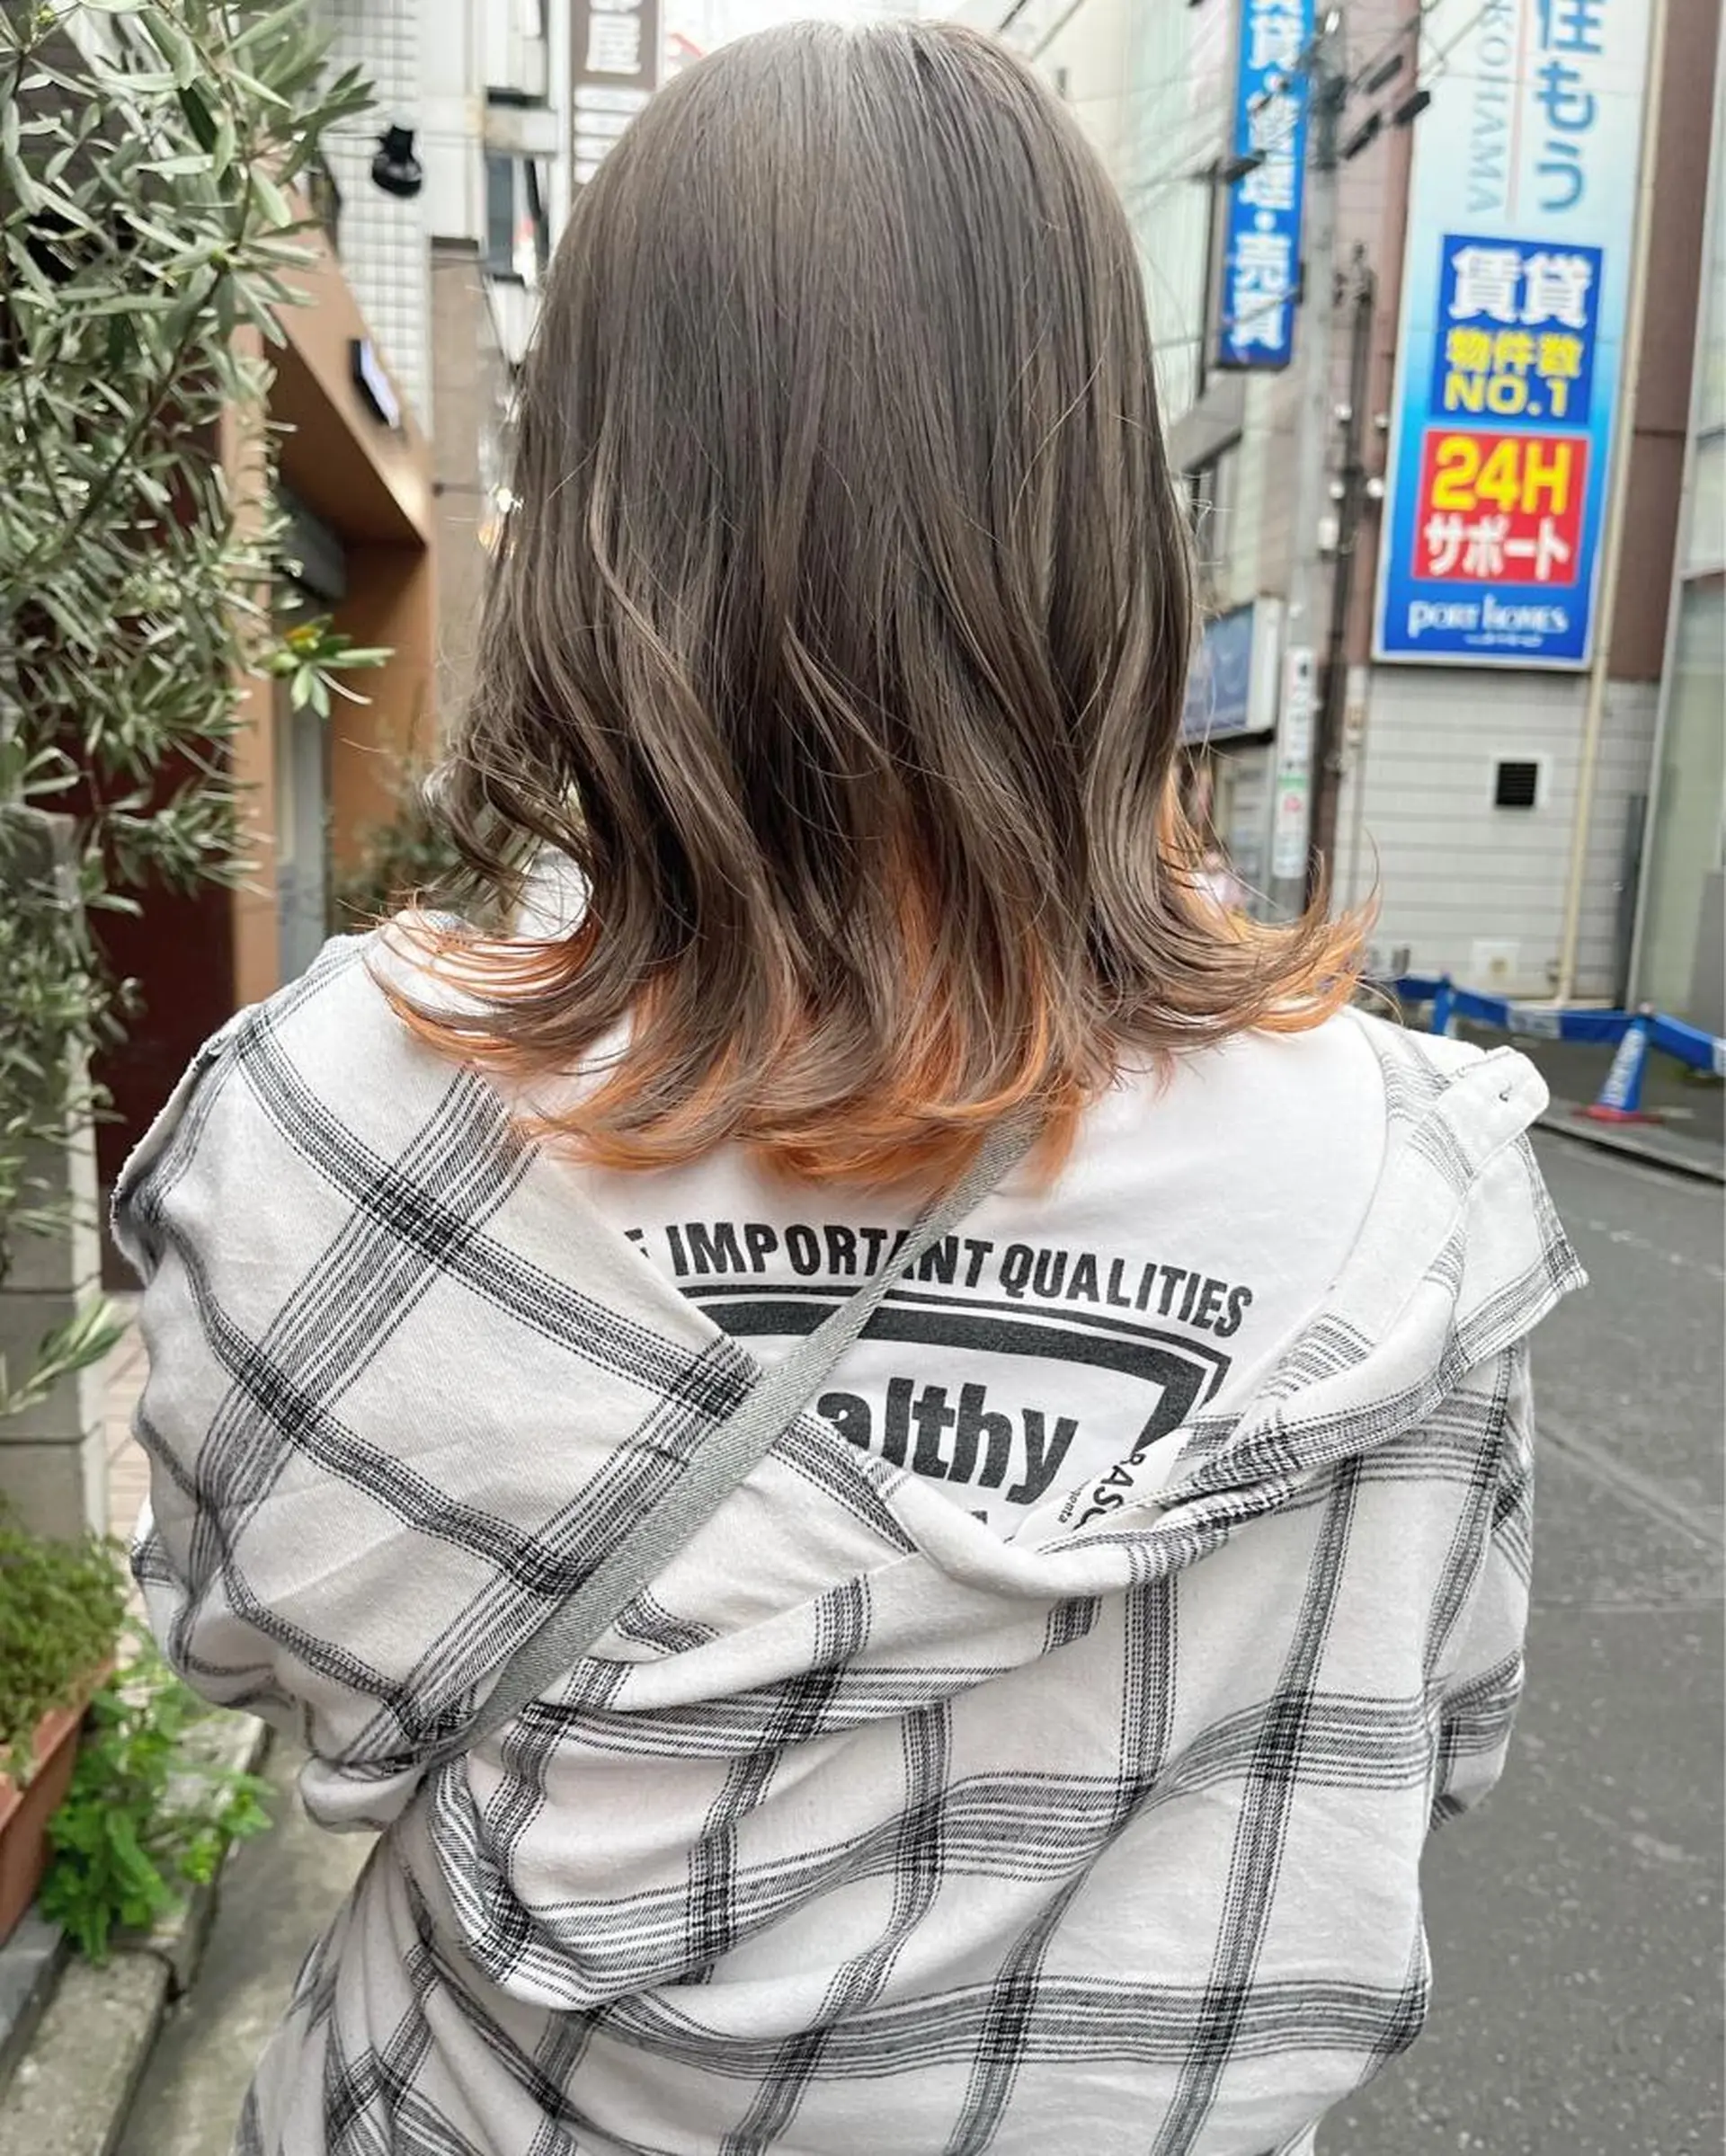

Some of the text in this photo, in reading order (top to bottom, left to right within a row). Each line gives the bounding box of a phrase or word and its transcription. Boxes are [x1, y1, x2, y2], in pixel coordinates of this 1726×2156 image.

[1448, 245, 1592, 328] 賃貸
[1443, 376, 1570, 417] NO.1
[1431, 435, 1571, 515] 24H
[1424, 513, 1571, 581] サポート
[999, 1243, 1253, 1337] QUALITIES
